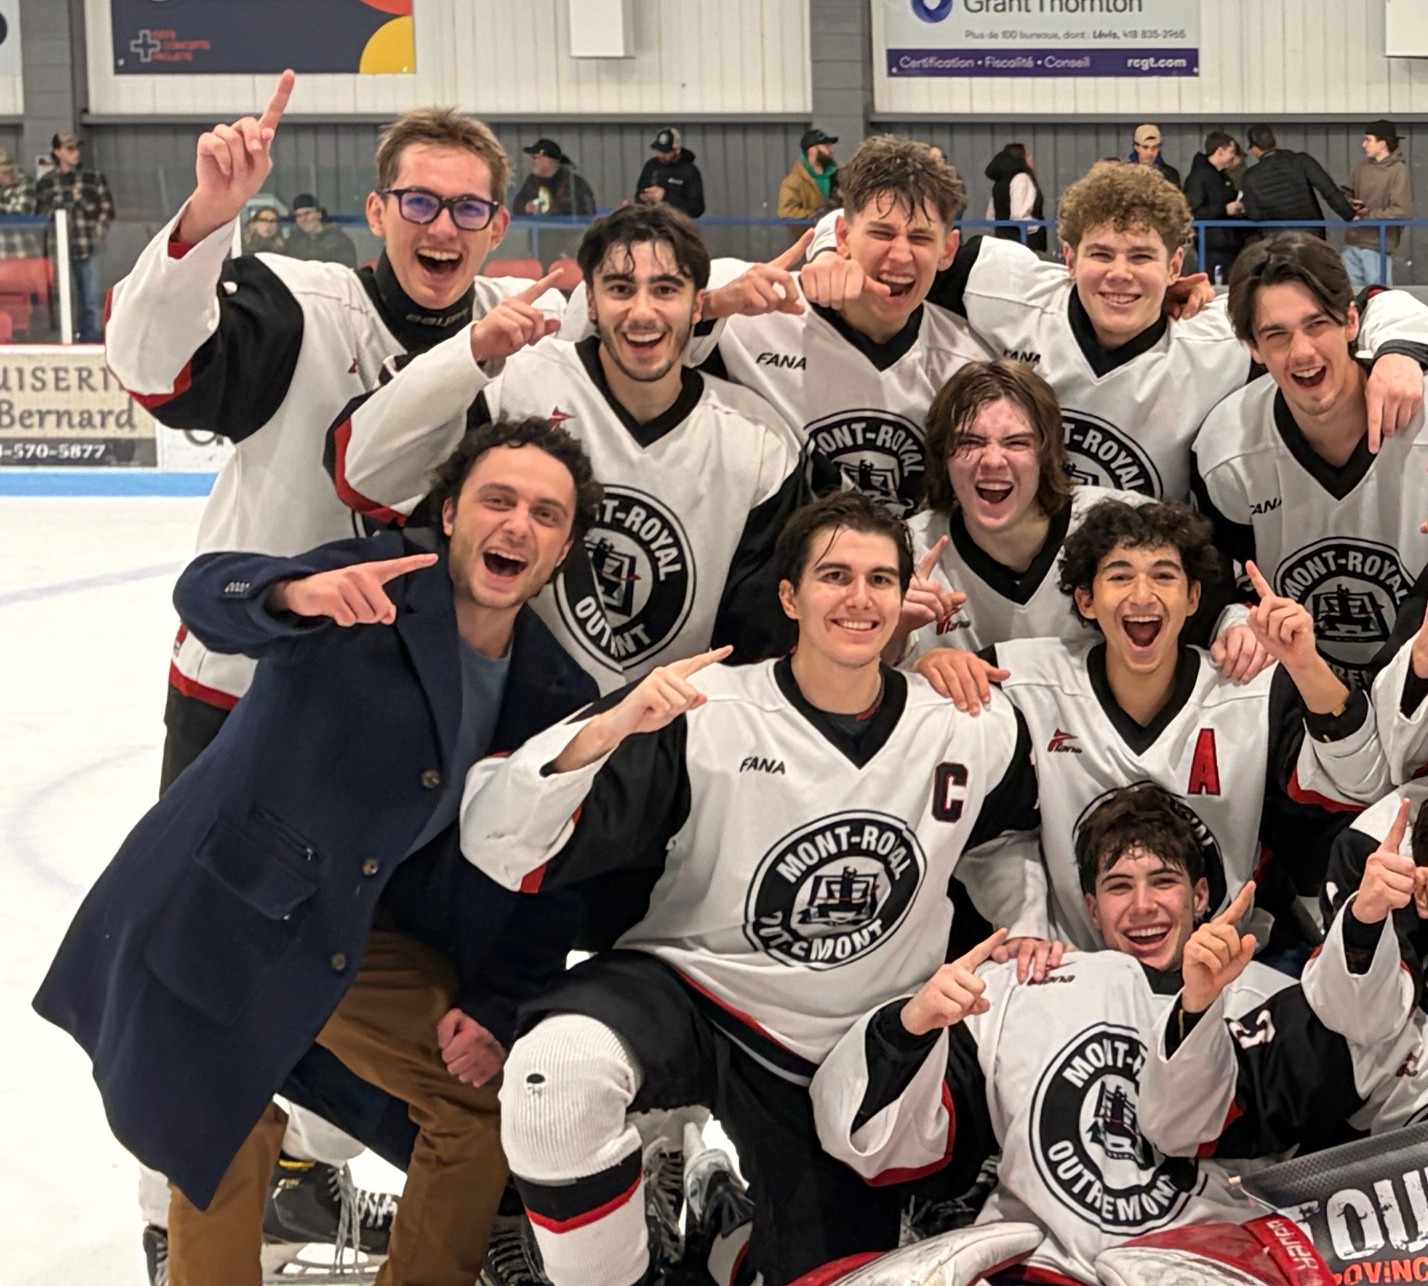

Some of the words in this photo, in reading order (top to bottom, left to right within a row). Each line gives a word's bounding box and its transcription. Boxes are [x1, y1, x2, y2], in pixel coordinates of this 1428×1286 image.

[900, 56, 974, 69] Certification
[985, 56, 1034, 69] Fiscalité
[1044, 56, 1091, 69] Conseil
[1127, 58, 1187, 71] rcgt.com
[756, 352, 807, 371] FANA
[815, 422, 925, 478] ONT-ROYAL
[738, 756, 786, 775] FANA
[1187, 727, 1222, 797] A
[931, 761, 969, 824] C
